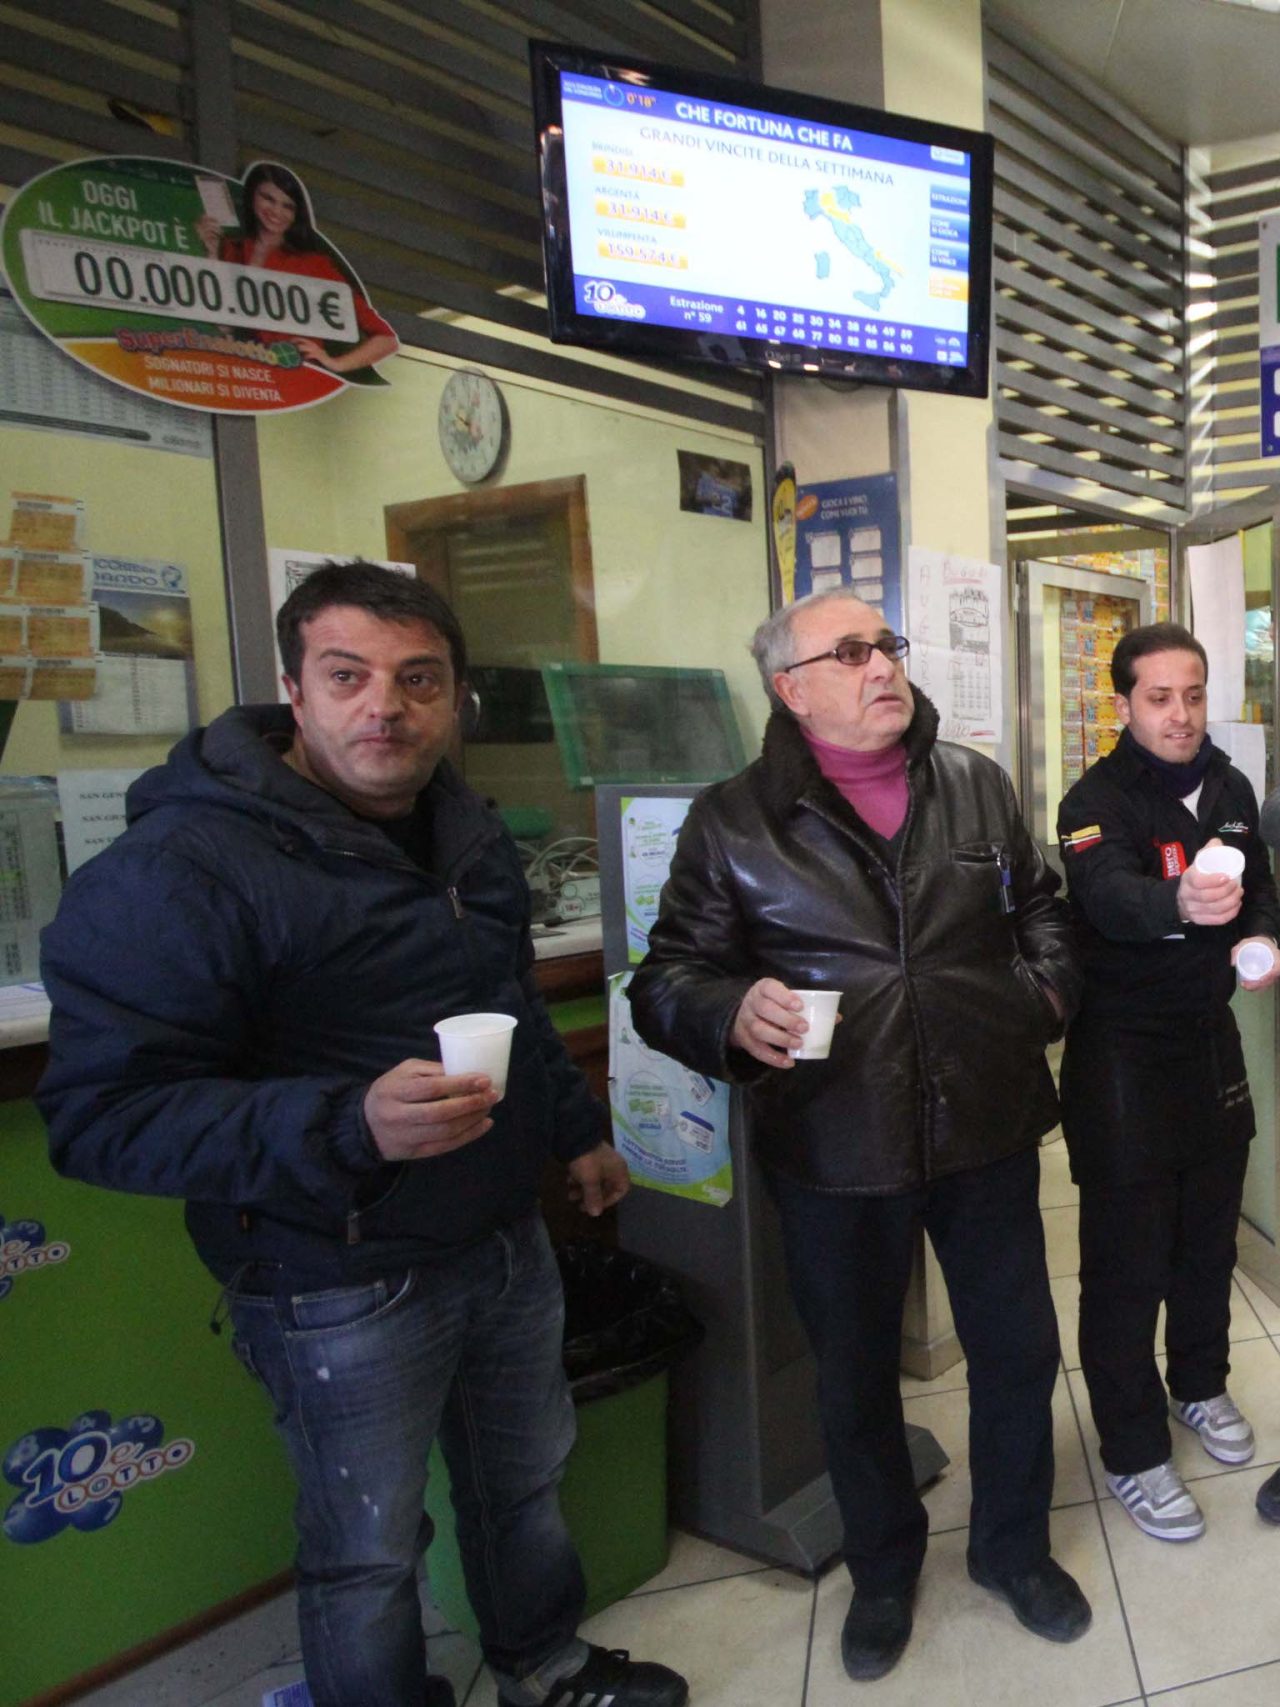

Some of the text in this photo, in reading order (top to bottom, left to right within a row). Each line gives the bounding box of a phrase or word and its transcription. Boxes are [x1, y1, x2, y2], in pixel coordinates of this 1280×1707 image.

[675, 101, 854, 152] CHE FORTUNA CHE FA
[640, 126, 894, 186] GRANDI VINCITE DELLA SETTIMANA
[80, 179, 138, 213] OGGI
[38, 201, 191, 250] IL JACKPOT È
[584, 281, 616, 304] 10
[669, 296, 724, 314] Estrazione
[736, 305, 746, 316] 4
[755, 308, 767, 320] 16
[811, 330, 823, 342] 77
[144, 355, 214, 378] SOGNATORI
[216, 363, 229, 379] SI
[149, 376, 214, 397] MILIONARI
[217, 383, 230, 398] SI
[1164, 847, 1176, 877] nero
[22, 1431, 112, 1508] 10
[54, 1437, 195, 1513] LOTTO
